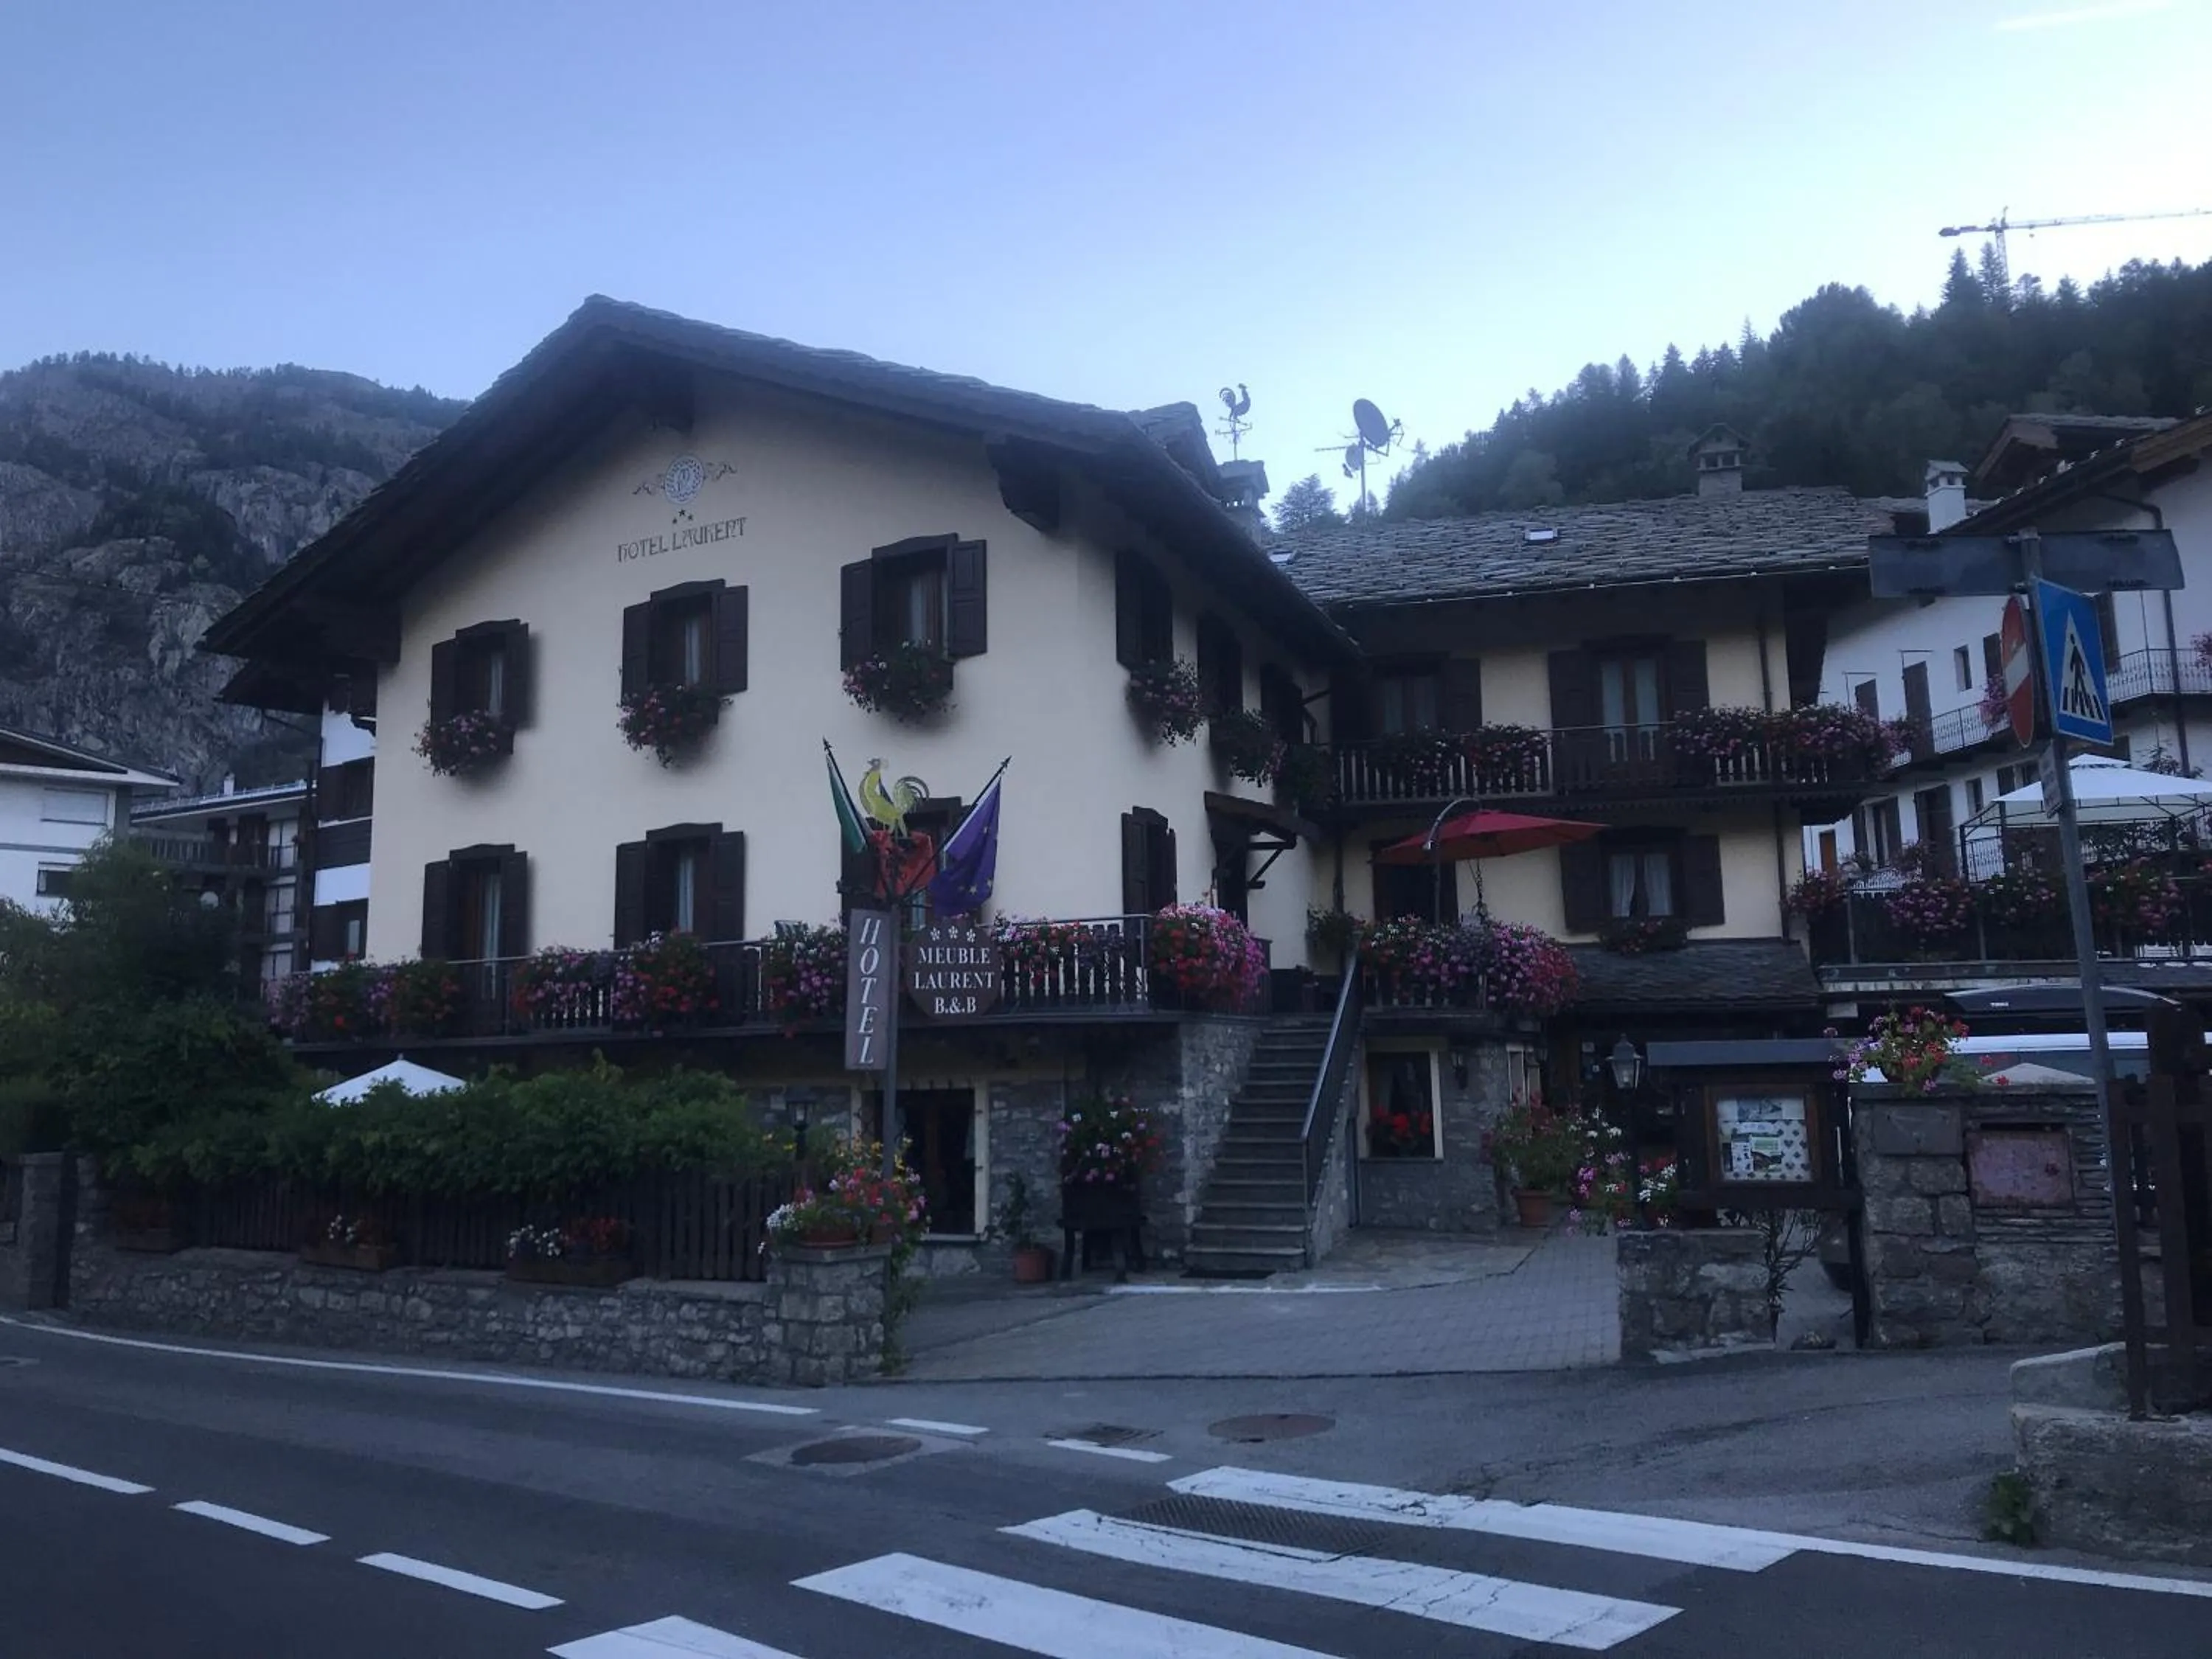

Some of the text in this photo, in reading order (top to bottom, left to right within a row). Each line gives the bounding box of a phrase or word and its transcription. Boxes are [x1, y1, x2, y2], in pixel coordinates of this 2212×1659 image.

[917, 947, 990, 964] MEUBLE
[914, 971, 995, 990] LAURENT
[858, 917, 882, 1064] HOTEL
